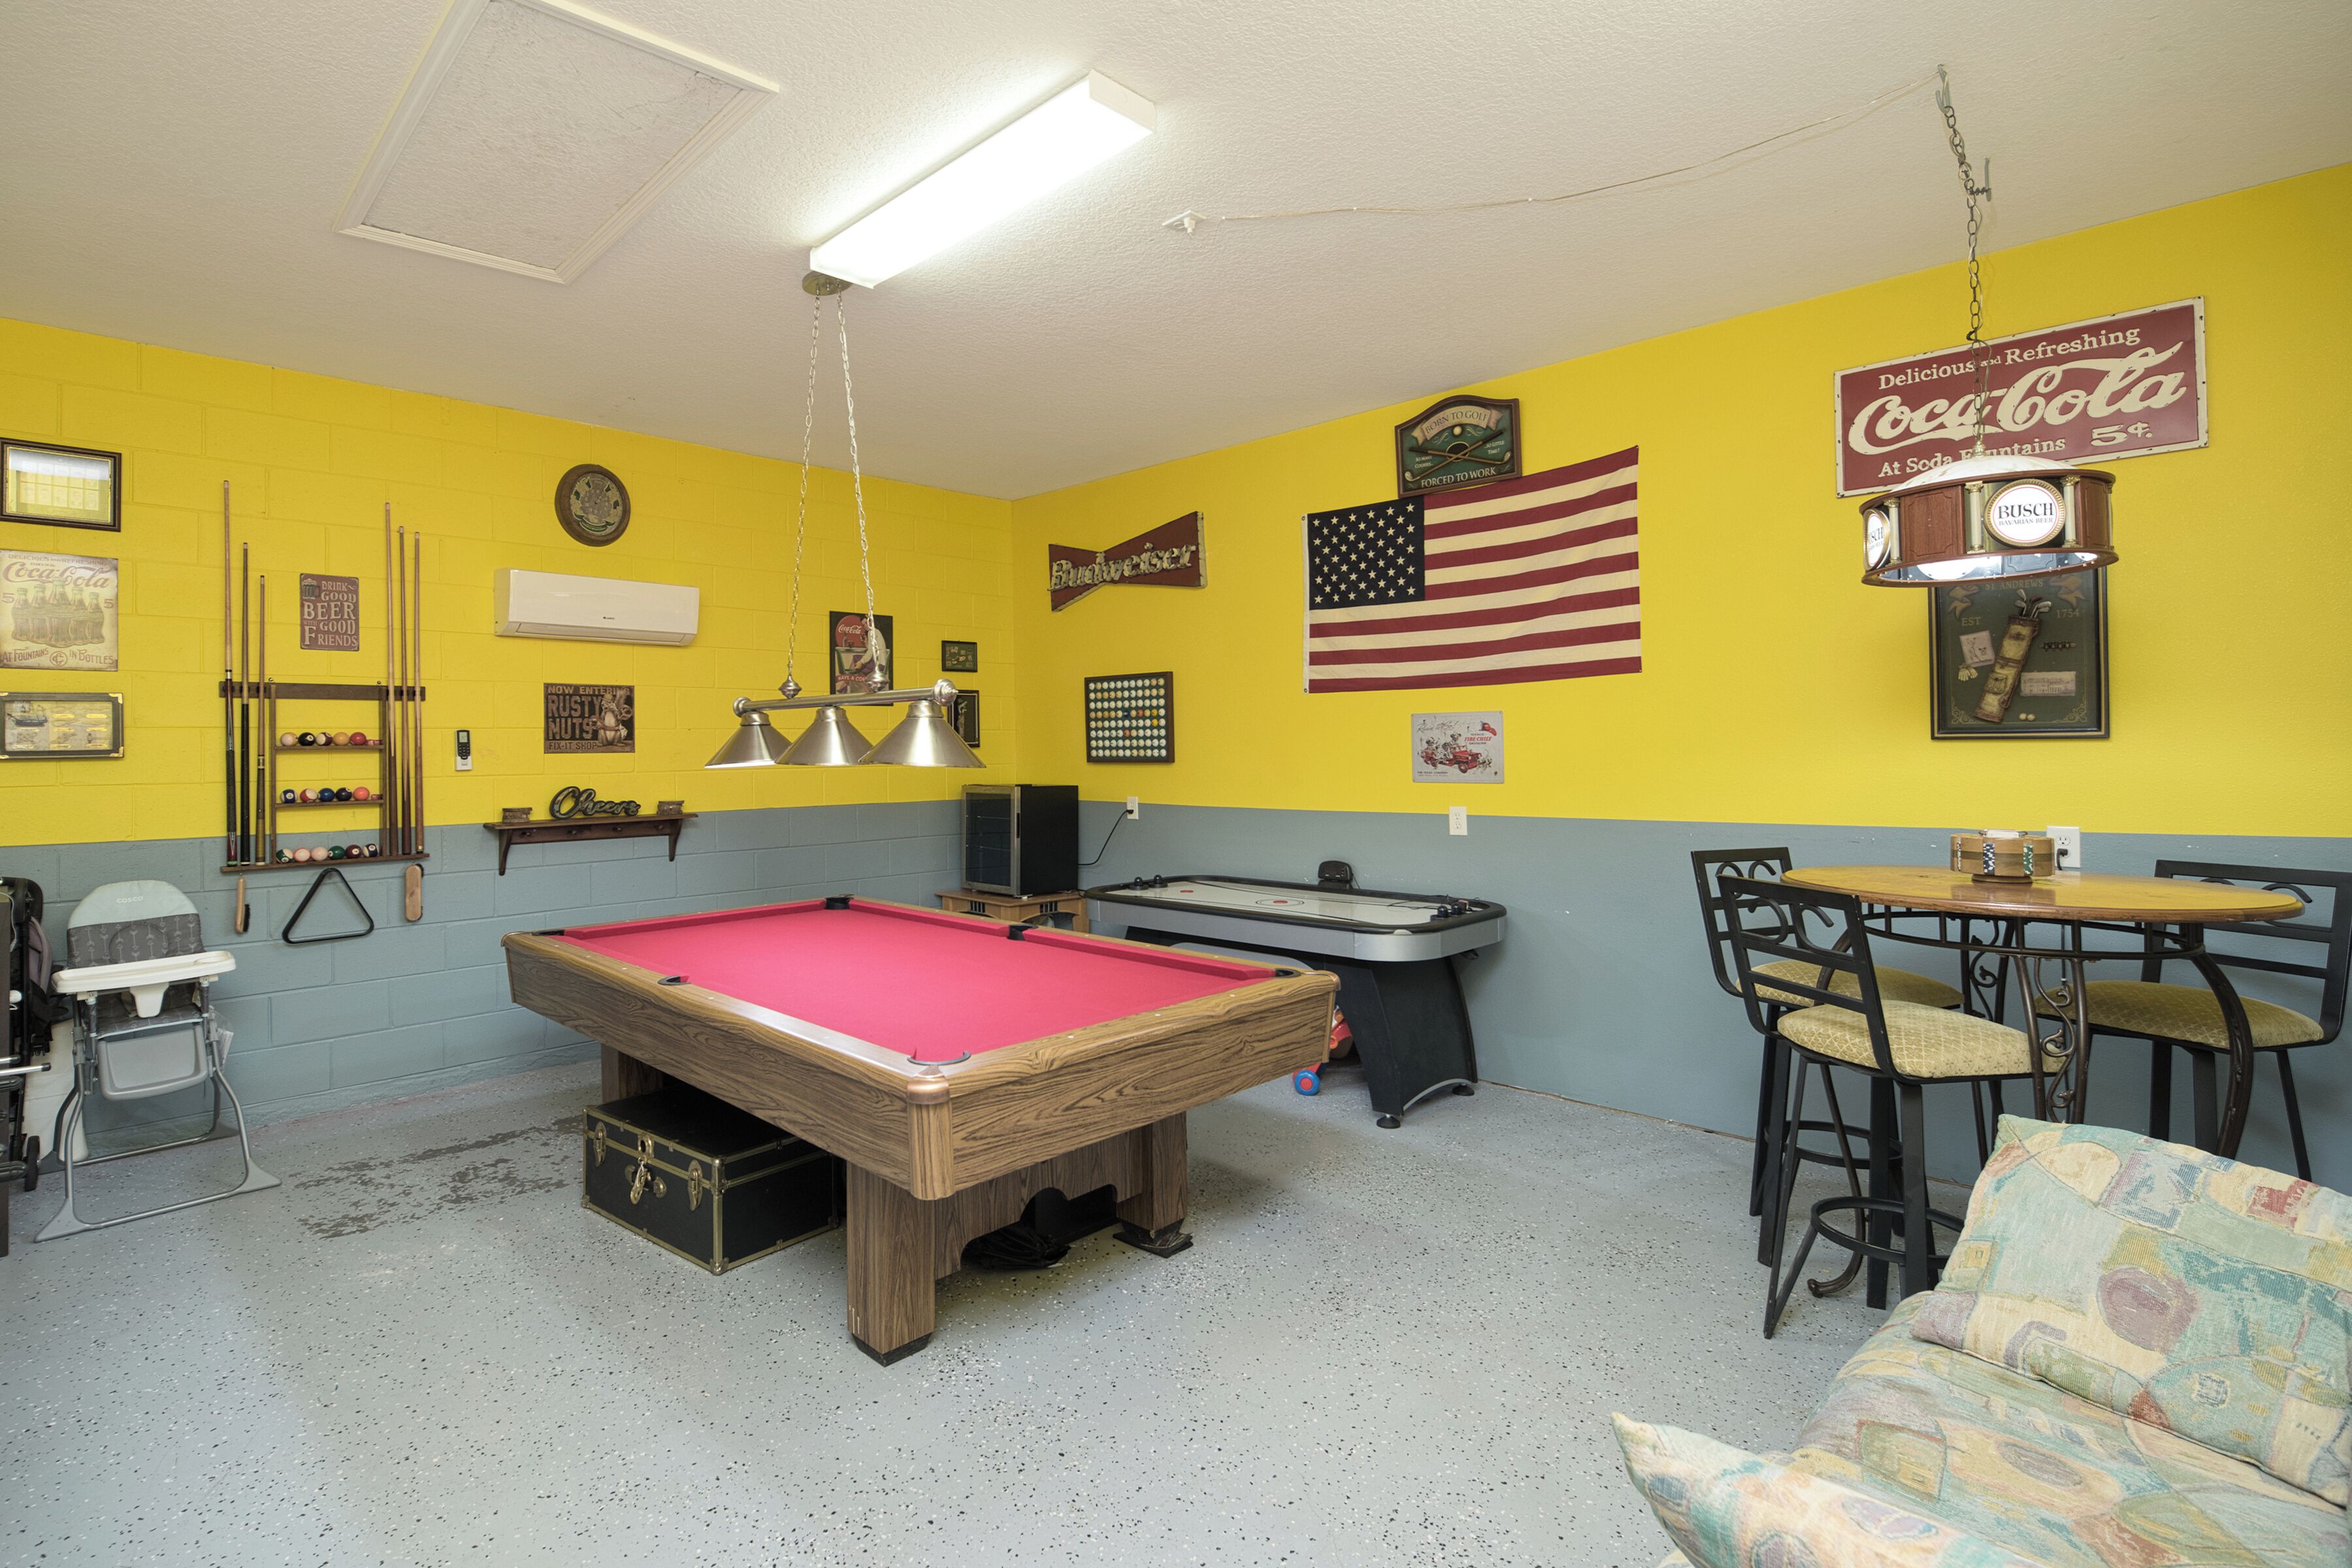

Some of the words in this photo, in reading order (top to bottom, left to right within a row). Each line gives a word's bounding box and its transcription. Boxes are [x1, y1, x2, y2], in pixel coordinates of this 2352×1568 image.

[1878, 359, 1974, 389] Delicious
[2004, 327, 2140, 365] Refreshing
[1848, 340, 2187, 455] Coca-Cola
[1425, 414, 1448, 434] BORN
[1450, 411, 1463, 420] TO
[1464, 410, 1487, 422] GOLF
[1878, 462, 1901, 478] At
[1906, 453, 1952, 473] Soda
[1959, 438, 2066, 459] Funtains
[1421, 475, 1454, 488] FORCED
[1456, 471, 1468, 482] TO
[1469, 466, 1496, 480] WORK
[1998, 502, 2053, 519] BUSCH
[3, 561, 112, 588] Coca-Cola
[1047, 542, 1197, 591] Budweiser
[2000, 578, 2044, 589] ANDREWS
[321, 591, 357, 603] GOOD
[303, 601, 356, 620] BEER
[2057, 609, 2080, 618] 1754
[319, 620, 355, 634] GOOD
[1961, 617, 1981, 626] EST
[304, 626, 357, 646] FRIENDS
[1, 653, 14, 662] AT
[11, 647, 49, 662] FOUNTAINS
[70, 649, 77, 658] IN
[78, 649, 114, 664] BOTTLES
[548, 685, 574, 694] NOW
[547, 694, 602, 717] RUSTY
[548, 717, 593, 740] NUTS
[549, 742, 573, 751] FIX-IT
[576, 742, 596, 750] SHOP
[549, 786, 641, 820] Cheers
